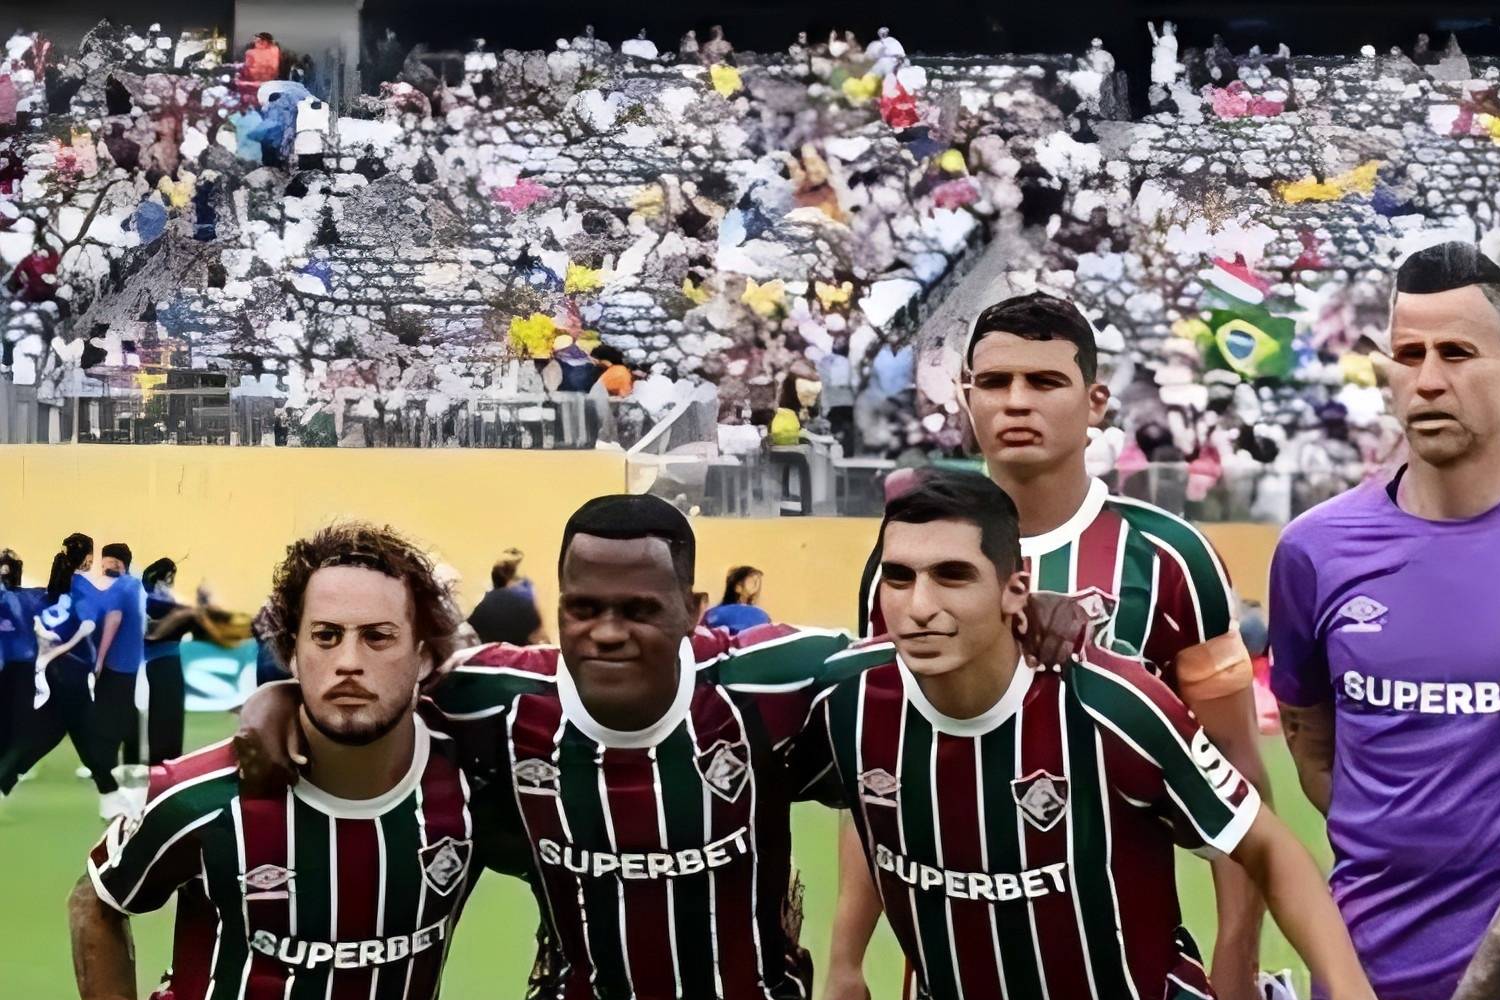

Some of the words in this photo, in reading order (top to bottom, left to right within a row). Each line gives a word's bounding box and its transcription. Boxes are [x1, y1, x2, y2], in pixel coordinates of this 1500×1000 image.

[539, 826, 748, 880] SUPERBET
[876, 843, 1067, 901] SUPERBET
[250, 914, 450, 969] SUPERBET
